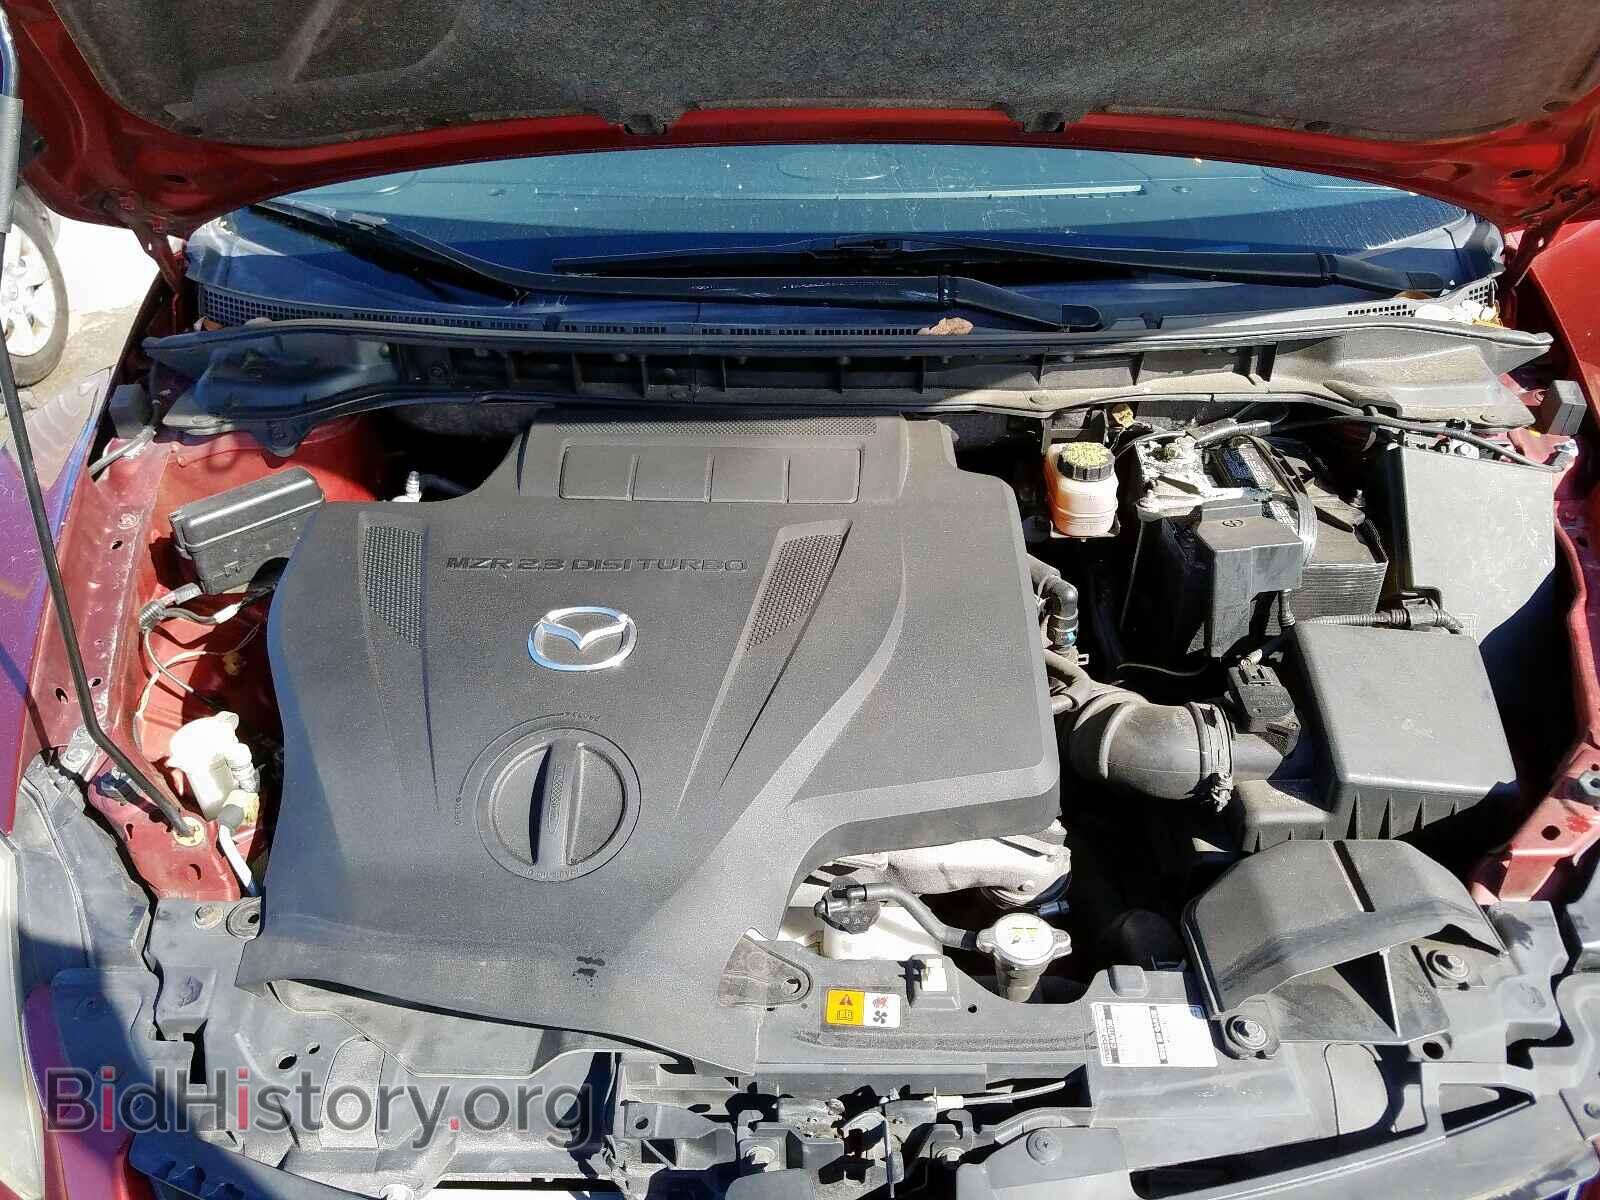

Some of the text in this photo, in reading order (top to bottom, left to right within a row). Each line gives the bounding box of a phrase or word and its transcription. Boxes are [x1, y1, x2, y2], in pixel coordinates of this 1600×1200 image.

[446, 557, 749, 572] MZR 2.3 DISI TURBO
